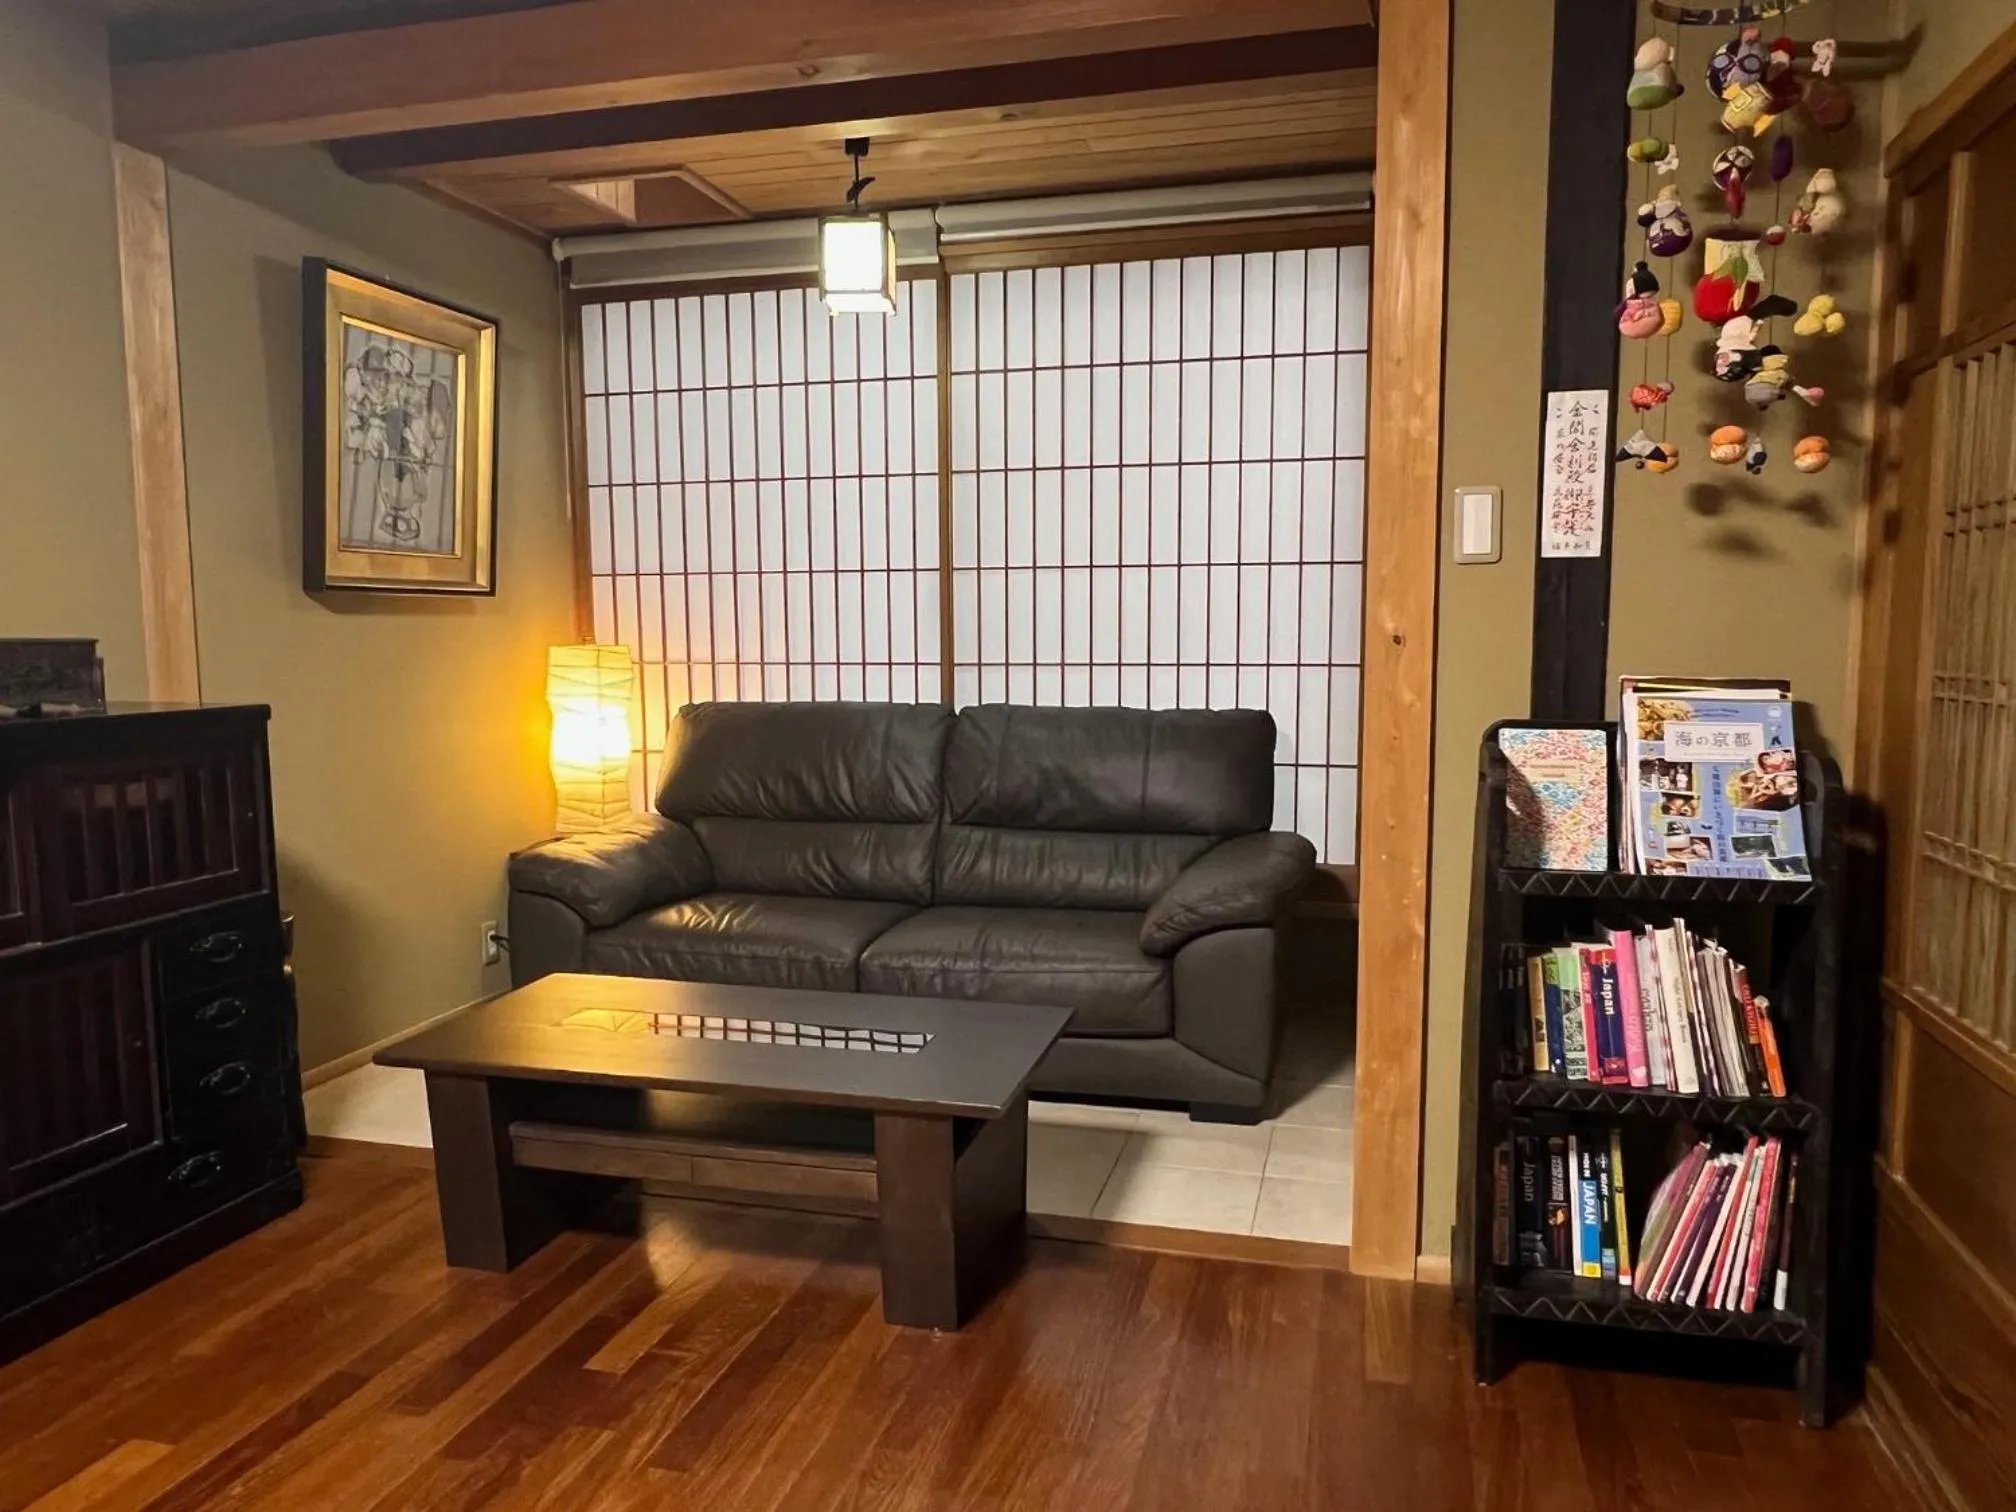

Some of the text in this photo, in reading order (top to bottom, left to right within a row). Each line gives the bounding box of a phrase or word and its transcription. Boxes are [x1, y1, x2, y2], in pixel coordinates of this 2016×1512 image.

[1673, 730, 1753, 748] 海の京都
[1601, 977, 1615, 1016] Japan
[1520, 1162, 1537, 1202] Japan
[1582, 1180, 1597, 1225] JAPAN
